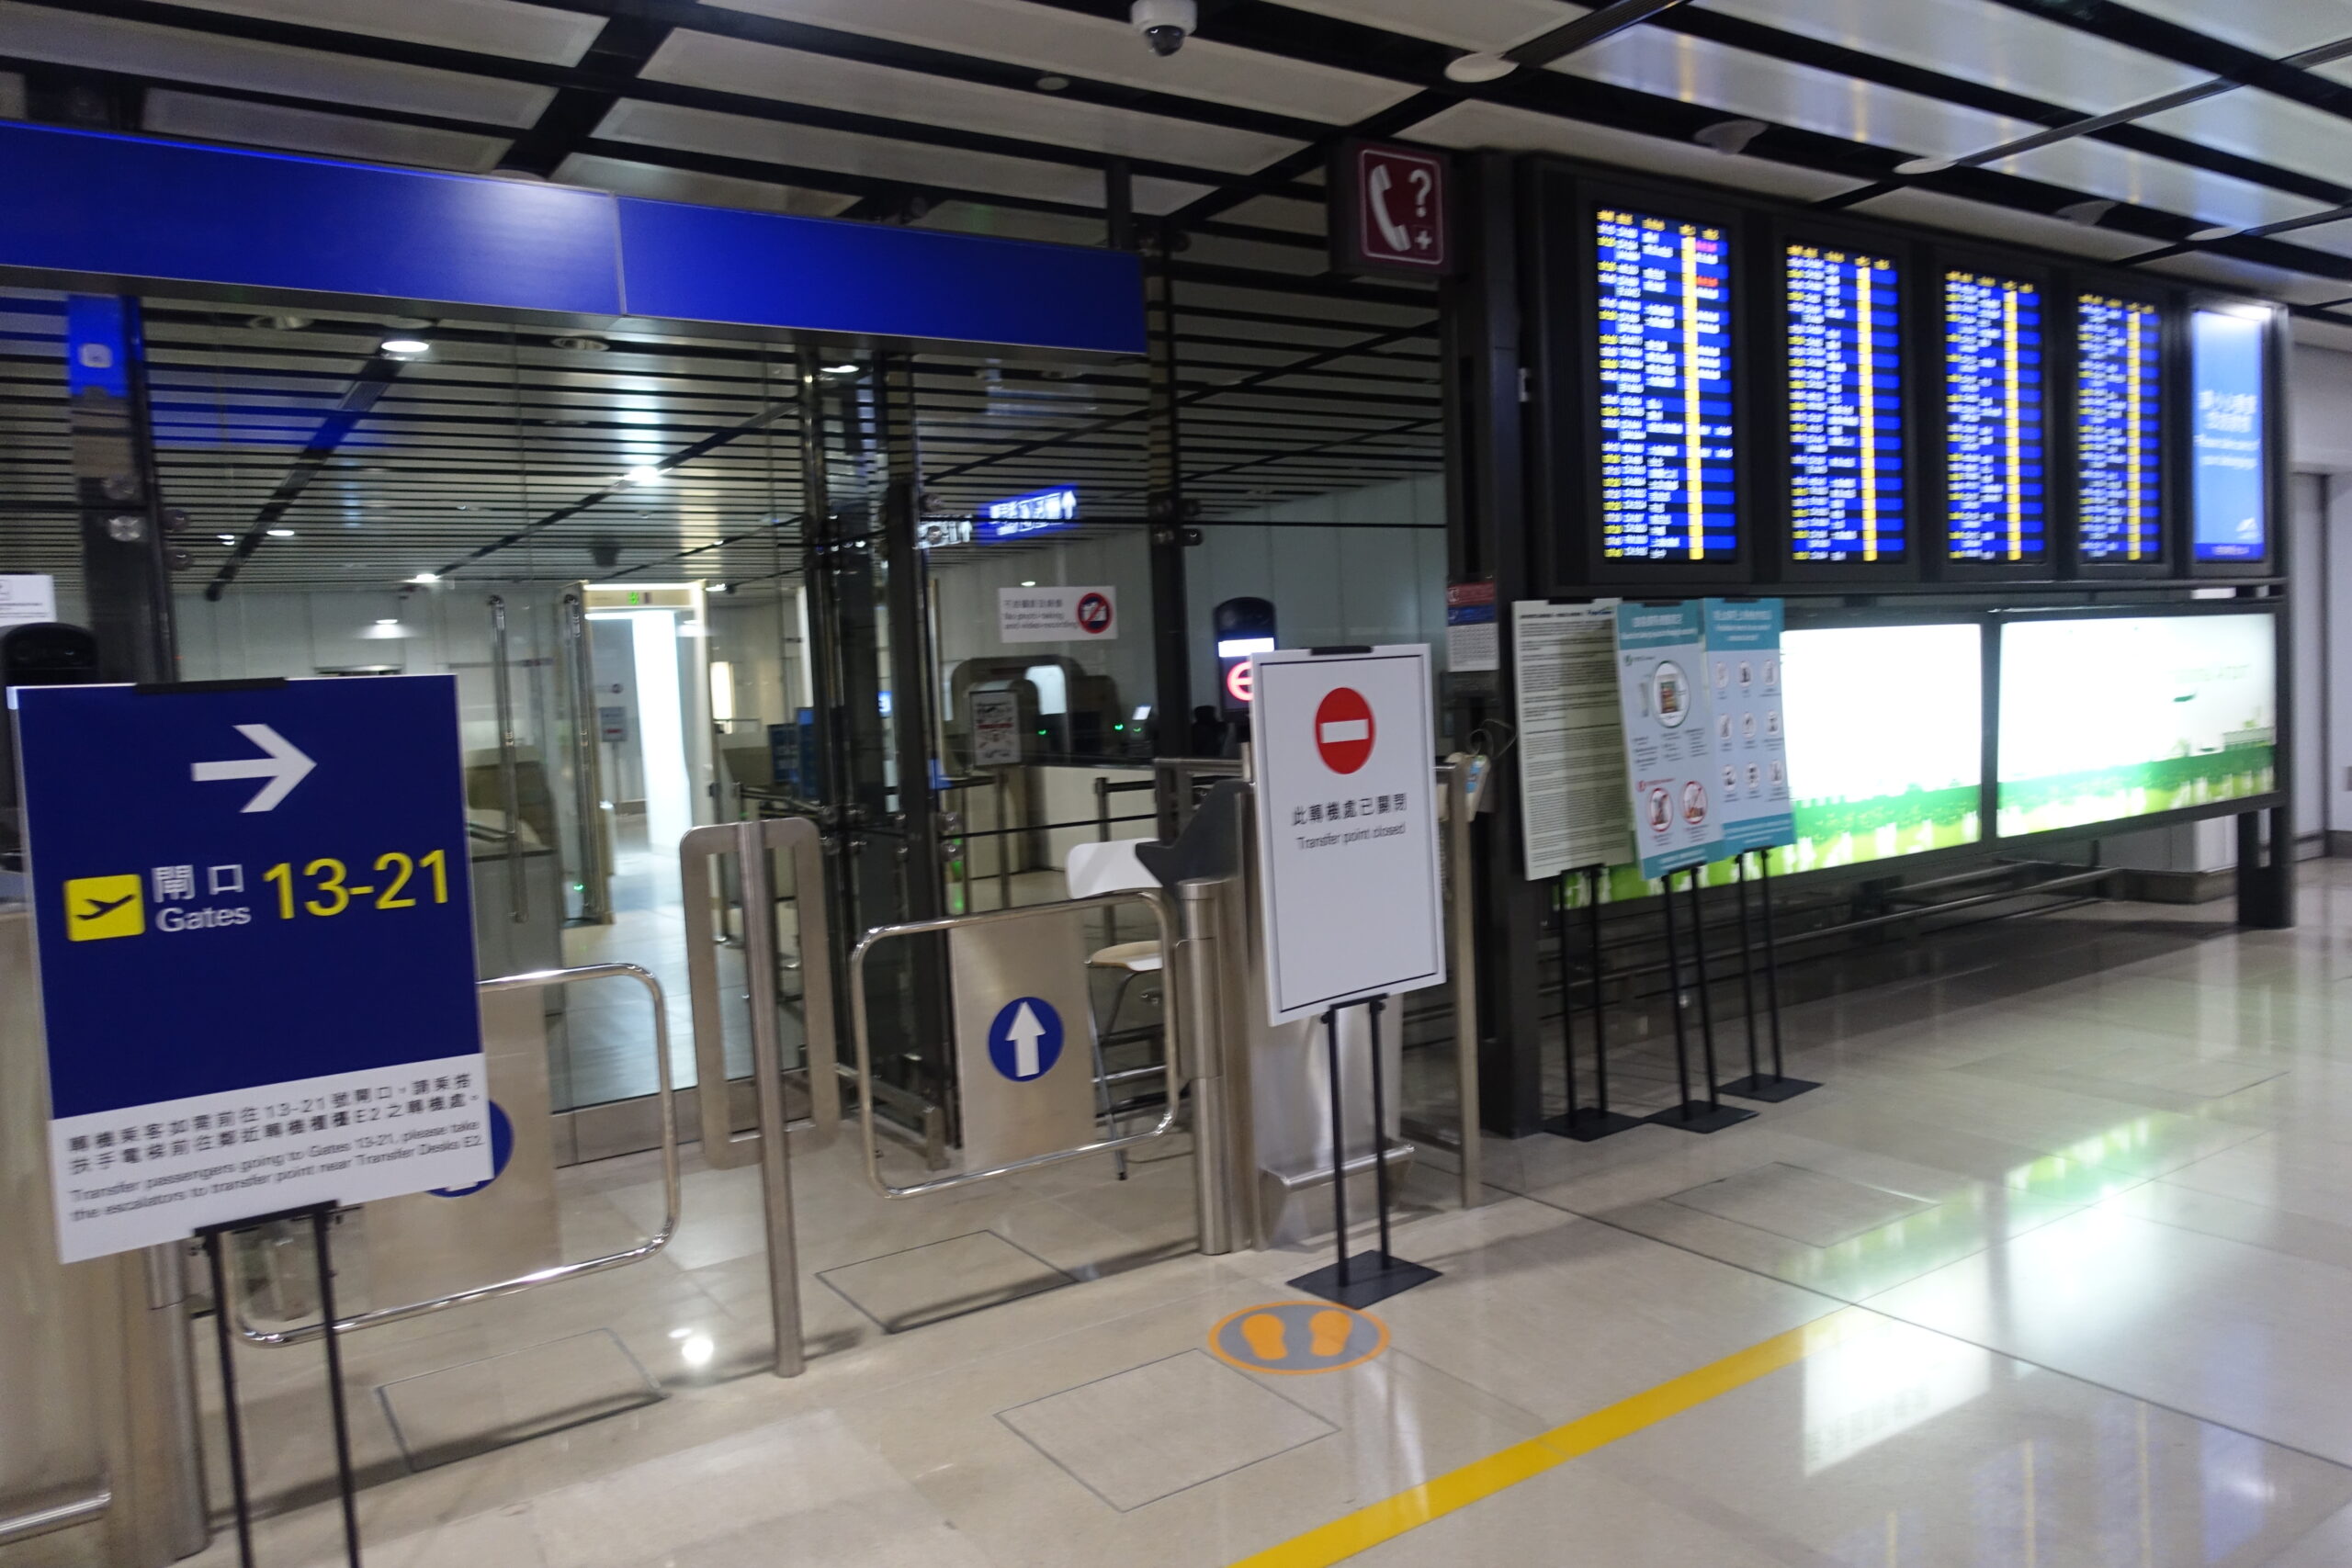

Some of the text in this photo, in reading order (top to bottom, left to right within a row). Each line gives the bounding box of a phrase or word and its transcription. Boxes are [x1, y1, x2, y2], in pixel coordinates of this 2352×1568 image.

[1296, 822, 1406, 850] Transfer point closed
[151, 863, 245, 903] 閘口
[155, 849, 449, 933] Gates 13-21
[70, 1120, 481, 1201] Transfer passengers going to Gates 13-21, please take
[71, 1207, 100, 1222] the
[105, 1191, 185, 1215] escalators
[189, 1185, 209, 1198] to
[210, 1172, 271, 1194] transfer
[276, 1165, 315, 1183] point
[319, 1158, 352, 1173] near
[354, 1148, 414, 1166] Transfer
[462, 1134, 485, 1149] E2
